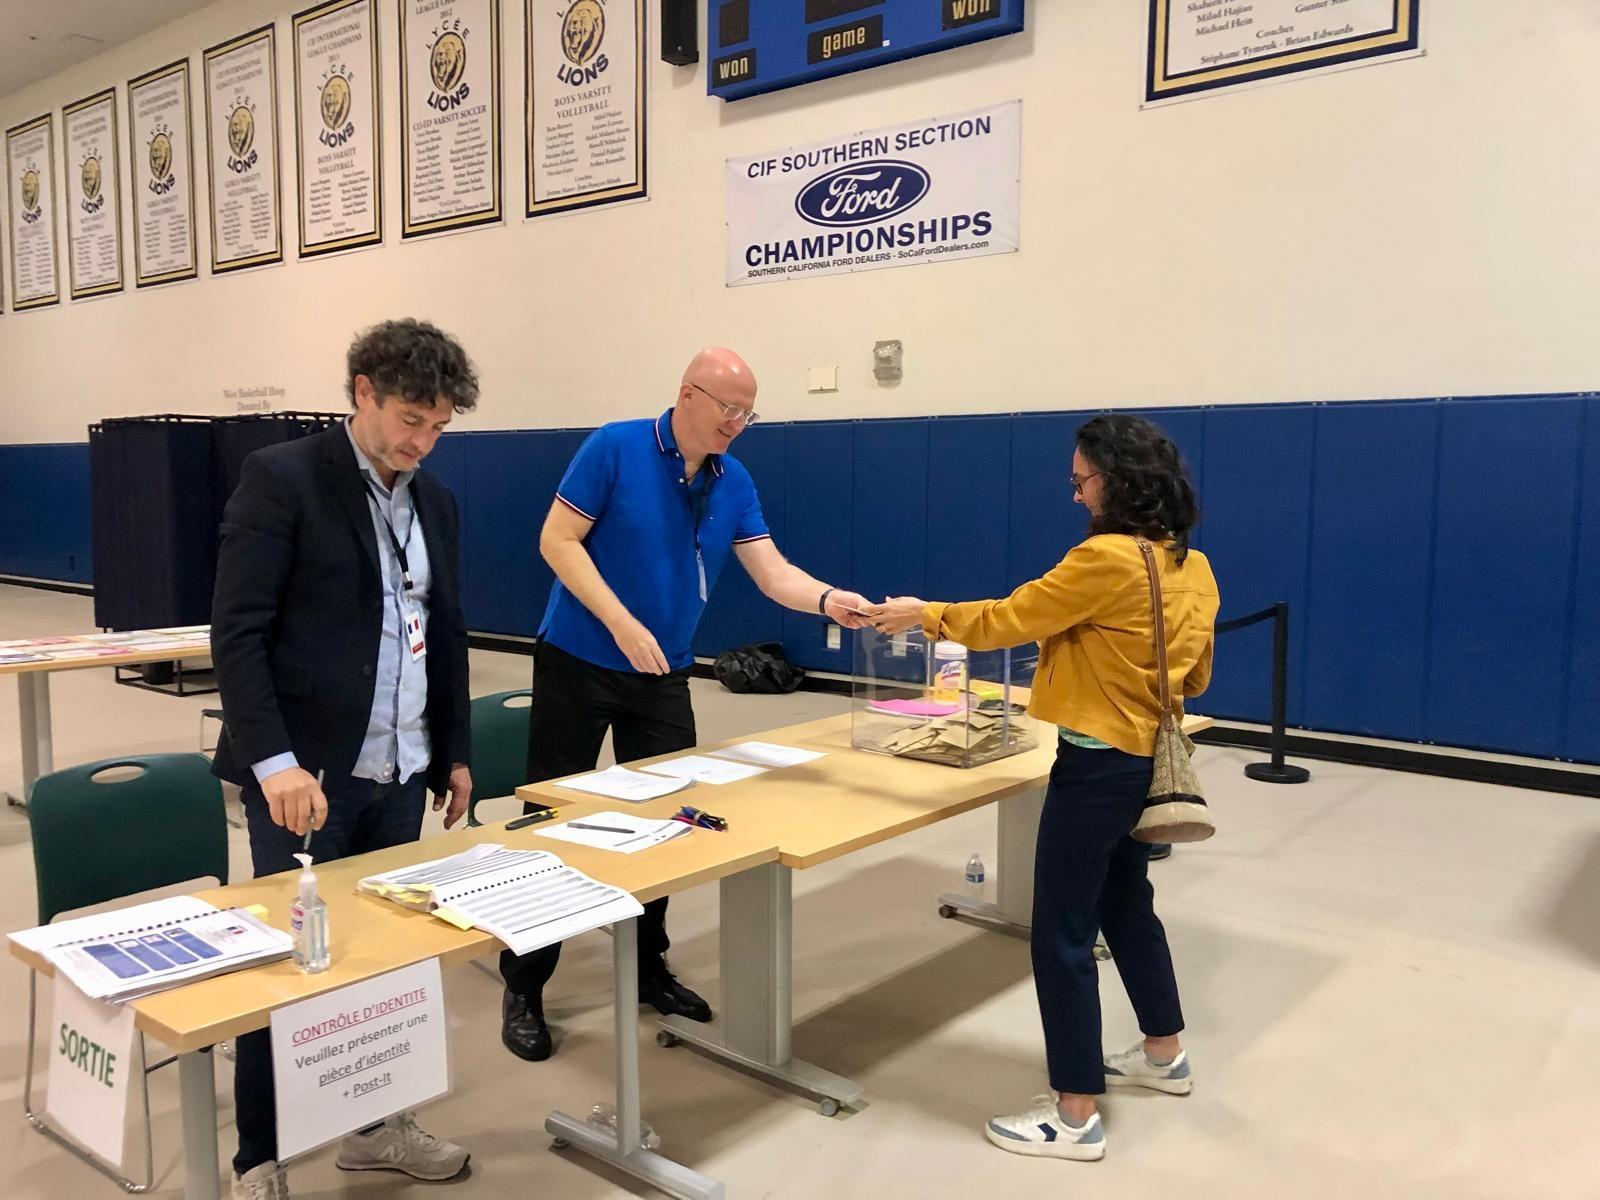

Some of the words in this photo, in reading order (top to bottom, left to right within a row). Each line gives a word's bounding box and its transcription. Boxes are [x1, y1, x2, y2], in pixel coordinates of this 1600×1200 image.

[426, 18, 470, 50] LYCÉE
[822, 26, 866, 59] game
[556, 53, 609, 86] LIONS
[720, 57, 749, 79] won
[427, 82, 470, 112] LIONS
[554, 94, 576, 108] BOYS
[577, 85, 612, 101] VARSITY
[556, 100, 609, 119] VOLLEYBALL
[433, 113, 459, 126] VARSITY
[460, 105, 487, 118] SOCCER
[318, 121, 355, 148] LIONS
[747, 159, 777, 179] CIF
[782, 136, 889, 173] SOUTHERN
[895, 115, 991, 151] SECTION
[227, 149, 258, 173] LIONS
[148, 173, 176, 196] LIONS
[820, 171, 902, 218] Ford
[745, 211, 993, 267] CHAMPIONSHIPS
[748, 267, 786, 278] SOUTHERN
[787, 261, 831, 273] CALIFORNIA
[832, 257, 854, 268] FORD
[855, 252, 891, 265] DEALERS
[898, 241, 989, 259] SoCalFordDealers.com
[292, 1012, 361, 1045] CONTRÔLE
[363, 987, 428, 1020] D'IDENTITE
[59, 1022, 117, 1088] SORTIE
[295, 1043, 345, 1069] Veuillez
[348, 1023, 404, 1053] présenter
[406, 1013, 429, 1029] une
[319, 1062, 352, 1086] pièce
[355, 1038, 411, 1070] d'identité
[343, 1090, 350, 1099] +
[353, 1071, 392, 1096] Post-It
